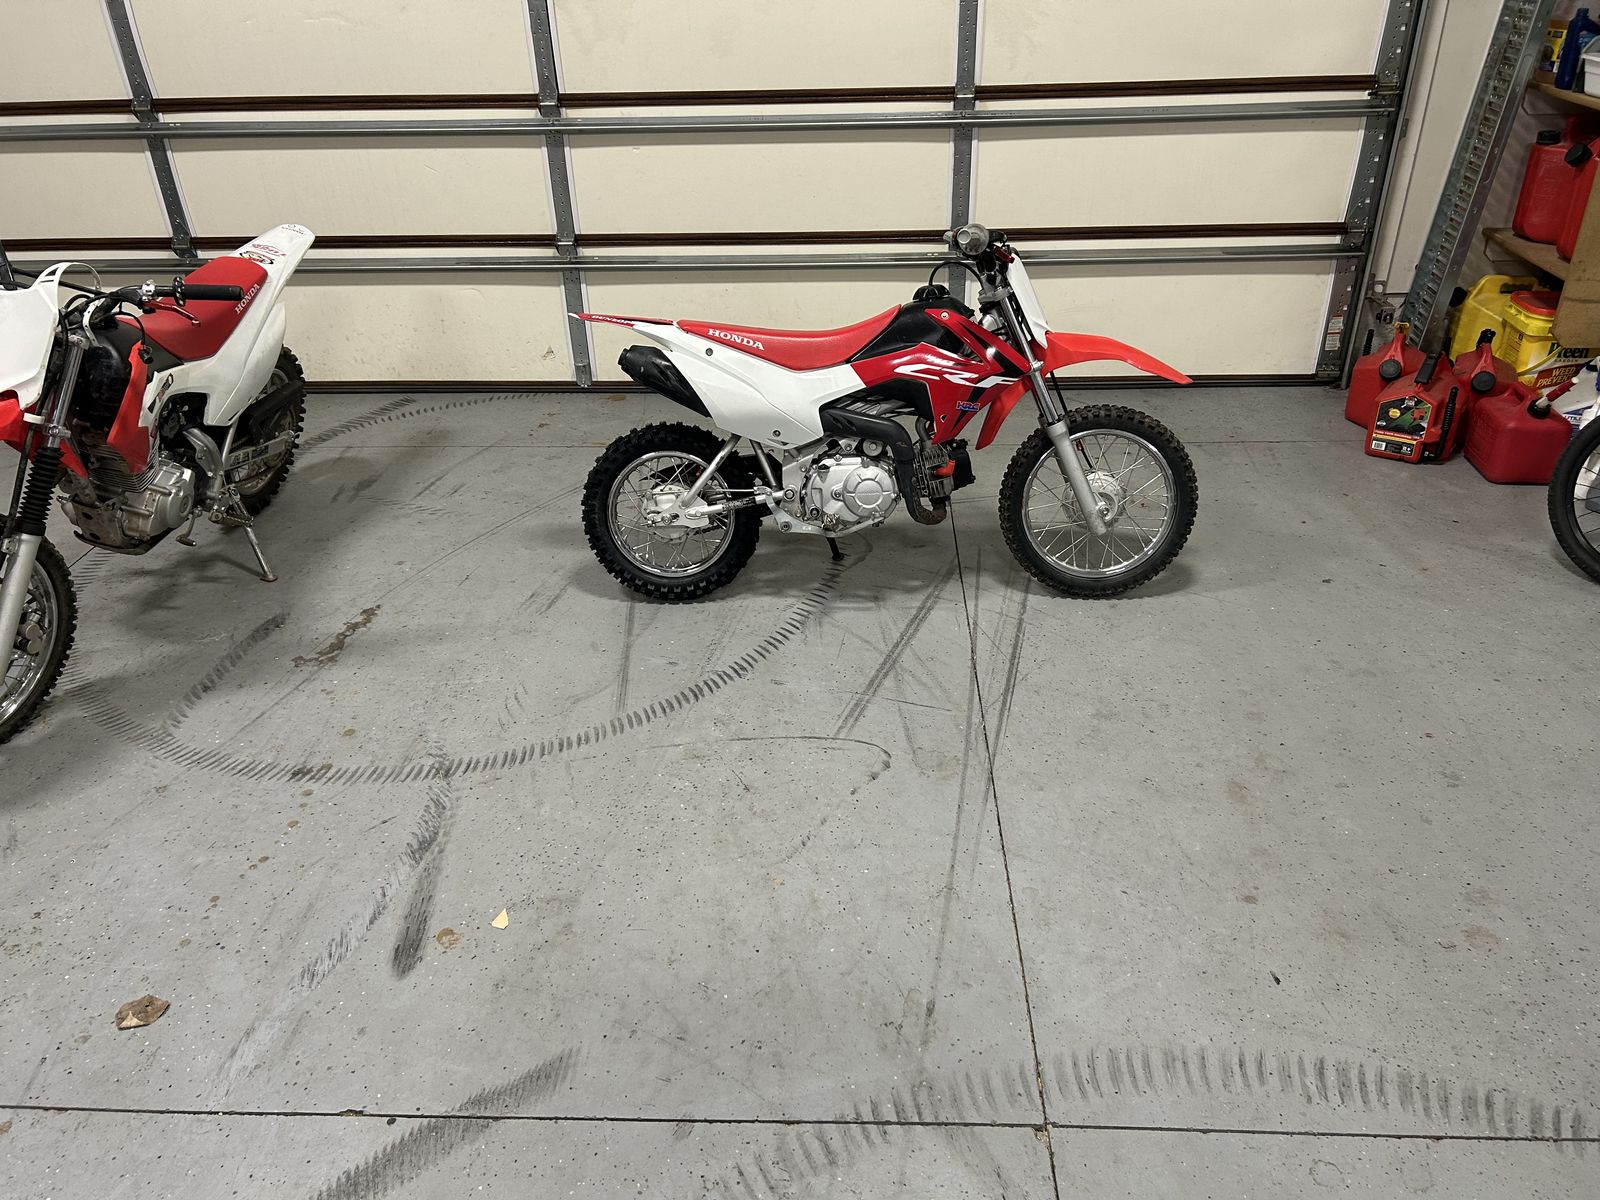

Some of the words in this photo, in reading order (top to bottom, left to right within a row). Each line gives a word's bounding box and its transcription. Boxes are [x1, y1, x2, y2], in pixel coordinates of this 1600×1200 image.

[235, 284, 260, 314] HONDA
[592, 315, 633, 325] DUNLOP
[708, 328, 765, 350] HONDA
[894, 364, 1020, 388] CRF
[1552, 367, 1576, 377] WEED
[956, 401, 980, 411] HRC
